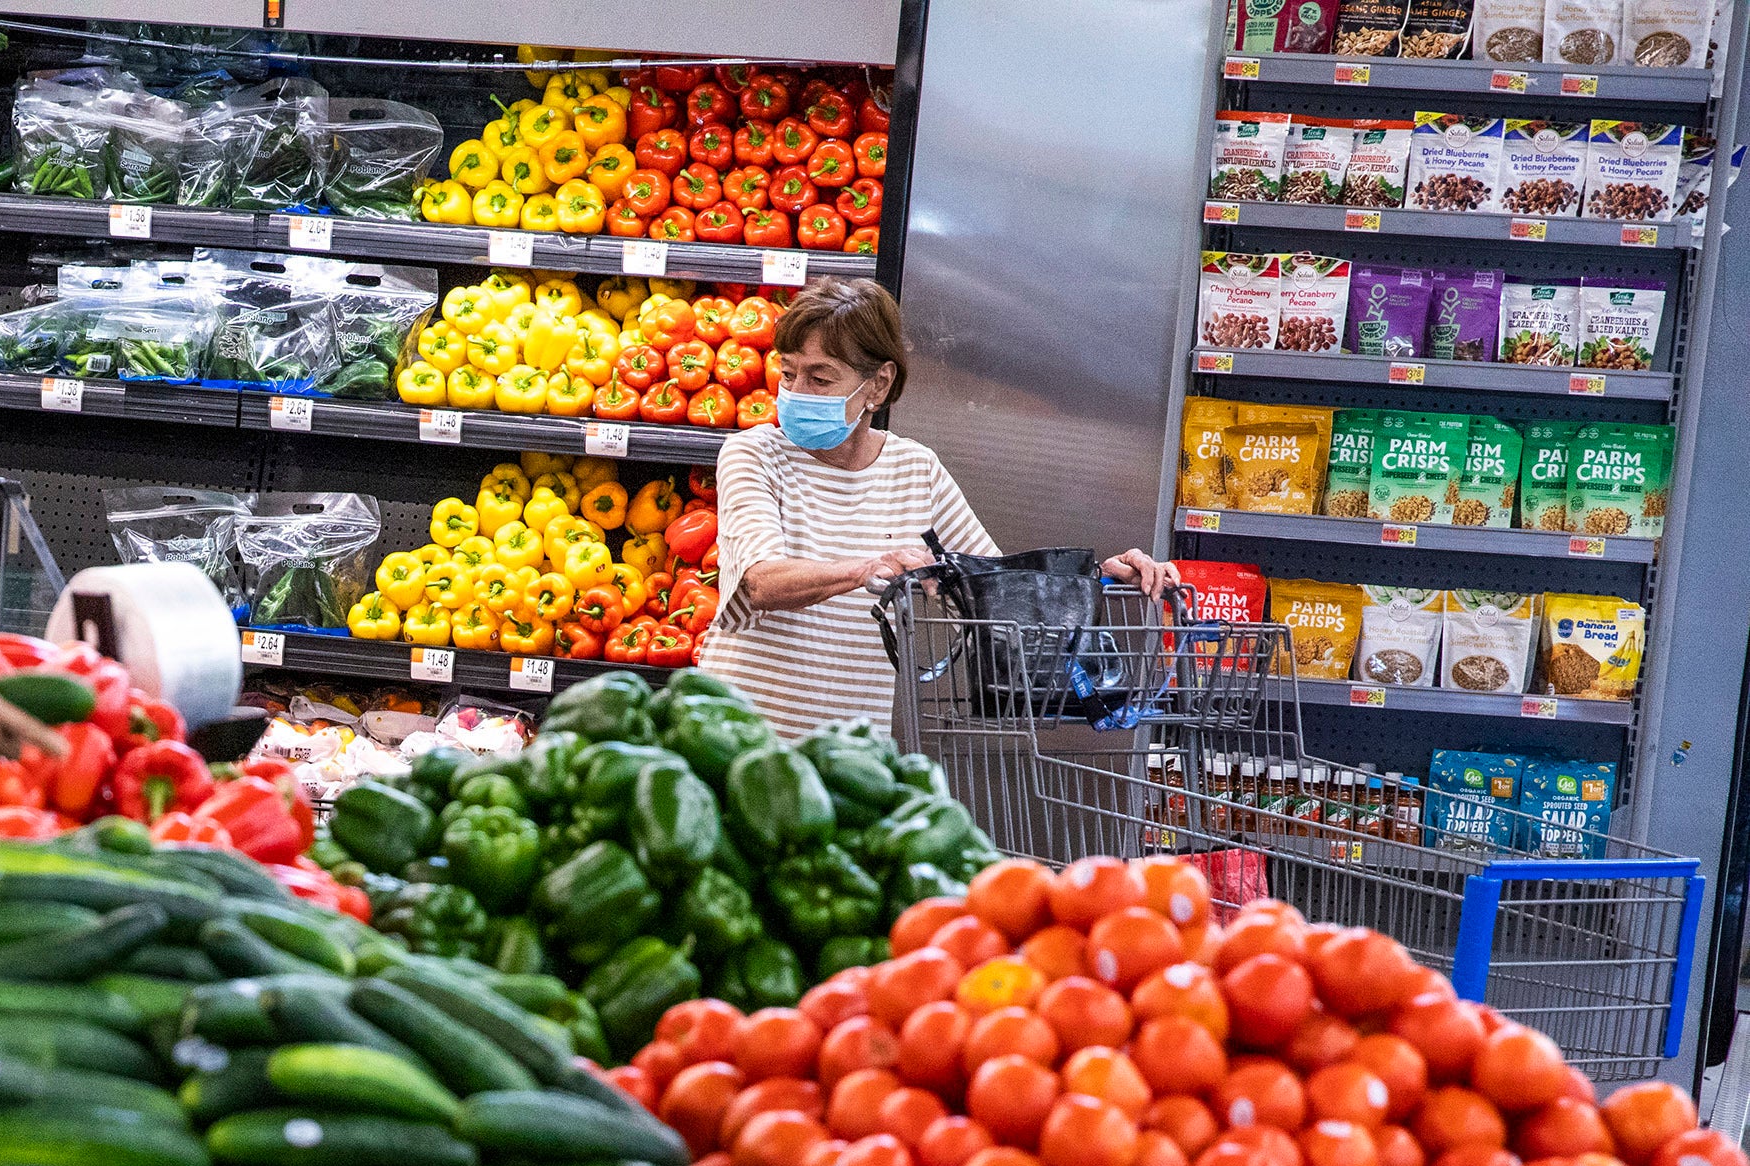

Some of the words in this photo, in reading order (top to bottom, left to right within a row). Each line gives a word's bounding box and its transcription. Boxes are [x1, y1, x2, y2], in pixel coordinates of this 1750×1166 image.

[1370, 5, 1402, 15] GINGER
[1431, 8, 1467, 19] GINGER
[1224, 148, 1262, 158] CRANBERRIES
[1286, 151, 1327, 160] CRANBERRIES
[1422, 148, 1444, 157] Dried
[1445, 148, 1489, 159] Blueberries
[1511, 154, 1533, 163] Dried
[1535, 154, 1580, 164] Blueberries
[120, 161, 149, 172] Serrano
[1432, 158, 1456, 168] Honey
[1458, 159, 1485, 168] Pecans
[1521, 162, 1546, 173] Honey
[1548, 163, 1576, 172] Pecans
[1598, 156, 1620, 166] Dried
[1622, 157, 1667, 168] Blueberries
[351, 165, 386, 174] Poblano
[1608, 166, 1633, 178] Honey
[1635, 168, 1663, 177] Pecans
[306, 219, 326, 234] $2.64
[1210, 284, 1234, 295] Cherry
[1234, 288, 1271, 299] Cranberry
[1298, 290, 1337, 300] Cranberry
[1590, 315, 1641, 326] CRANBERRIES
[1587, 324, 1613, 334] GLAZED
[1615, 326, 1650, 336] WALNUTS
[336, 332, 372, 343] Poblano
[58, 381, 77, 396] $1.58
[286, 401, 306, 415] $2.64
[435, 413, 456, 428] $1.48
[602, 427, 623, 441] $1.48
[1245, 434, 1297, 447] PARM
[1333, 433, 1375, 449] PAR
[1390, 438, 1447, 455] PARM
[1239, 446, 1301, 463] CRISPS
[1330, 448, 1373, 464] CRIS
[1583, 449, 1642, 466] PARM
[1381, 453, 1450, 473] CRISPS
[1381, 471, 1419, 480] SUPERSEEDS
[1426, 473, 1448, 481] CHEESE
[1576, 463, 1646, 485] CRISPS
[1480, 476, 1502, 485] CHEESE
[1576, 482, 1613, 491] SUPERSEEDS
[1620, 485, 1643, 494] CHEESE
[282, 560, 315, 569] Poblano
[1195, 592, 1248, 608] PARM
[1187, 605, 1250, 623] CRISPS
[1291, 601, 1342, 616] PARM
[1285, 613, 1346, 633] CRISPS
[1577, 620, 1616, 630] Banana
[1584, 630, 1618, 641] Bread
[258, 636, 278, 650] $2.64
[428, 652, 449, 667] $1.48
[526, 660, 548, 675] $1.48
[1459, 787, 1487, 795] ORGANIC
[1481, 796, 1496, 804] SEED
[1542, 801, 1573, 810] SPROUTED
[1573, 802, 1588, 811] SEED
[1541, 810, 1587, 829] SALAD
